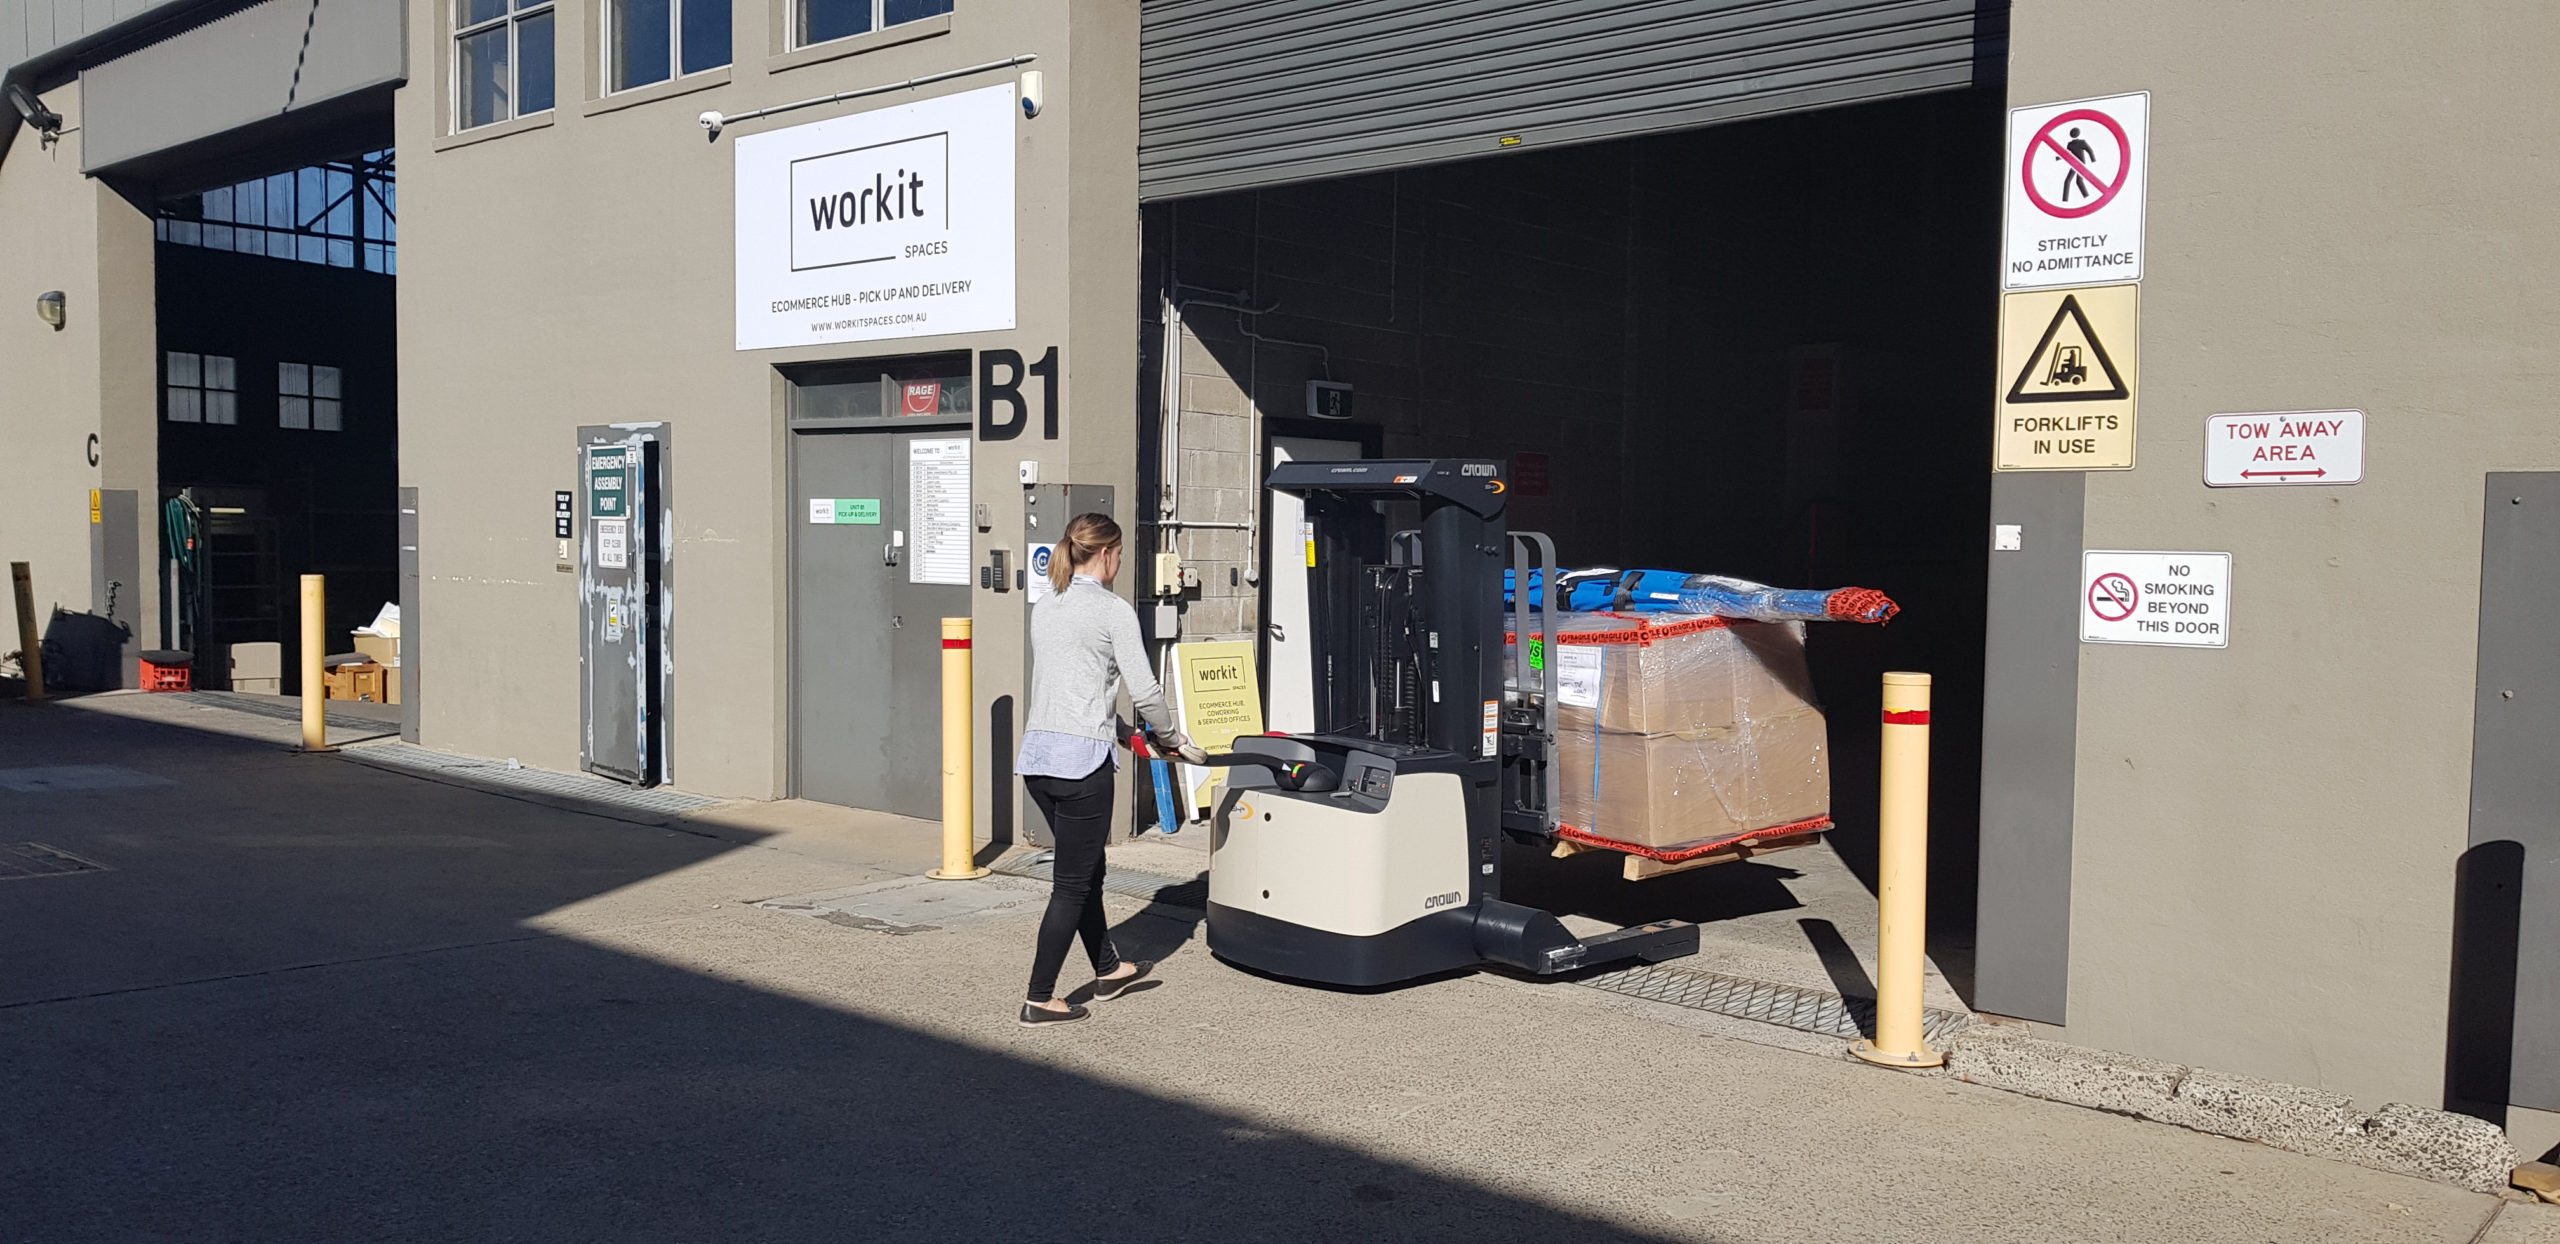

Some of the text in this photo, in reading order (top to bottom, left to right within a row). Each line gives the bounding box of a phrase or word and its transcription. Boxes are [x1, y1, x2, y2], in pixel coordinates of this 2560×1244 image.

[810, 168, 924, 231] workit
[904, 240, 948, 258] SPACES
[2037, 234, 2108, 252] STRICTLY
[2012, 252, 2134, 274] NO ADMITTANCE
[772, 294, 829, 313] ECOMMERCE
[831, 292, 851, 307] HUB
[859, 289, 881, 304] PICK
[883, 288, 897, 301] UP
[898, 285, 920, 299] AND
[922, 280, 972, 298] DELIVERY
[811, 312, 927, 332] WWW.WORKITSPACES.COM.AU
[909, 385, 933, 396] RAGE
[979, 345, 1059, 441] B1
[2014, 415, 2119, 433] FORKLIFTS
[2226, 420, 2343, 439] TOW AWAY
[87, 433, 99, 467] C
[2034, 439, 2095, 455] IN USE
[2253, 445, 2315, 462] AREA
[592, 455, 625, 470] EMERGENCY
[1461, 464, 1497, 477] CROWN
[594, 477, 623, 490] ASSEMBLY
[600, 497, 616, 511] POINT
[2168, 565, 2190, 577] NO
[2144, 583, 2215, 597] SMOKING
[2148, 602, 2209, 615] BEYOND
[2137, 620, 2220, 635] THIS DOOR
[1199, 665, 1238, 681] workit
[1229, 715, 1251, 723] OFFICES
[1425, 891, 1461, 909] CROWN
